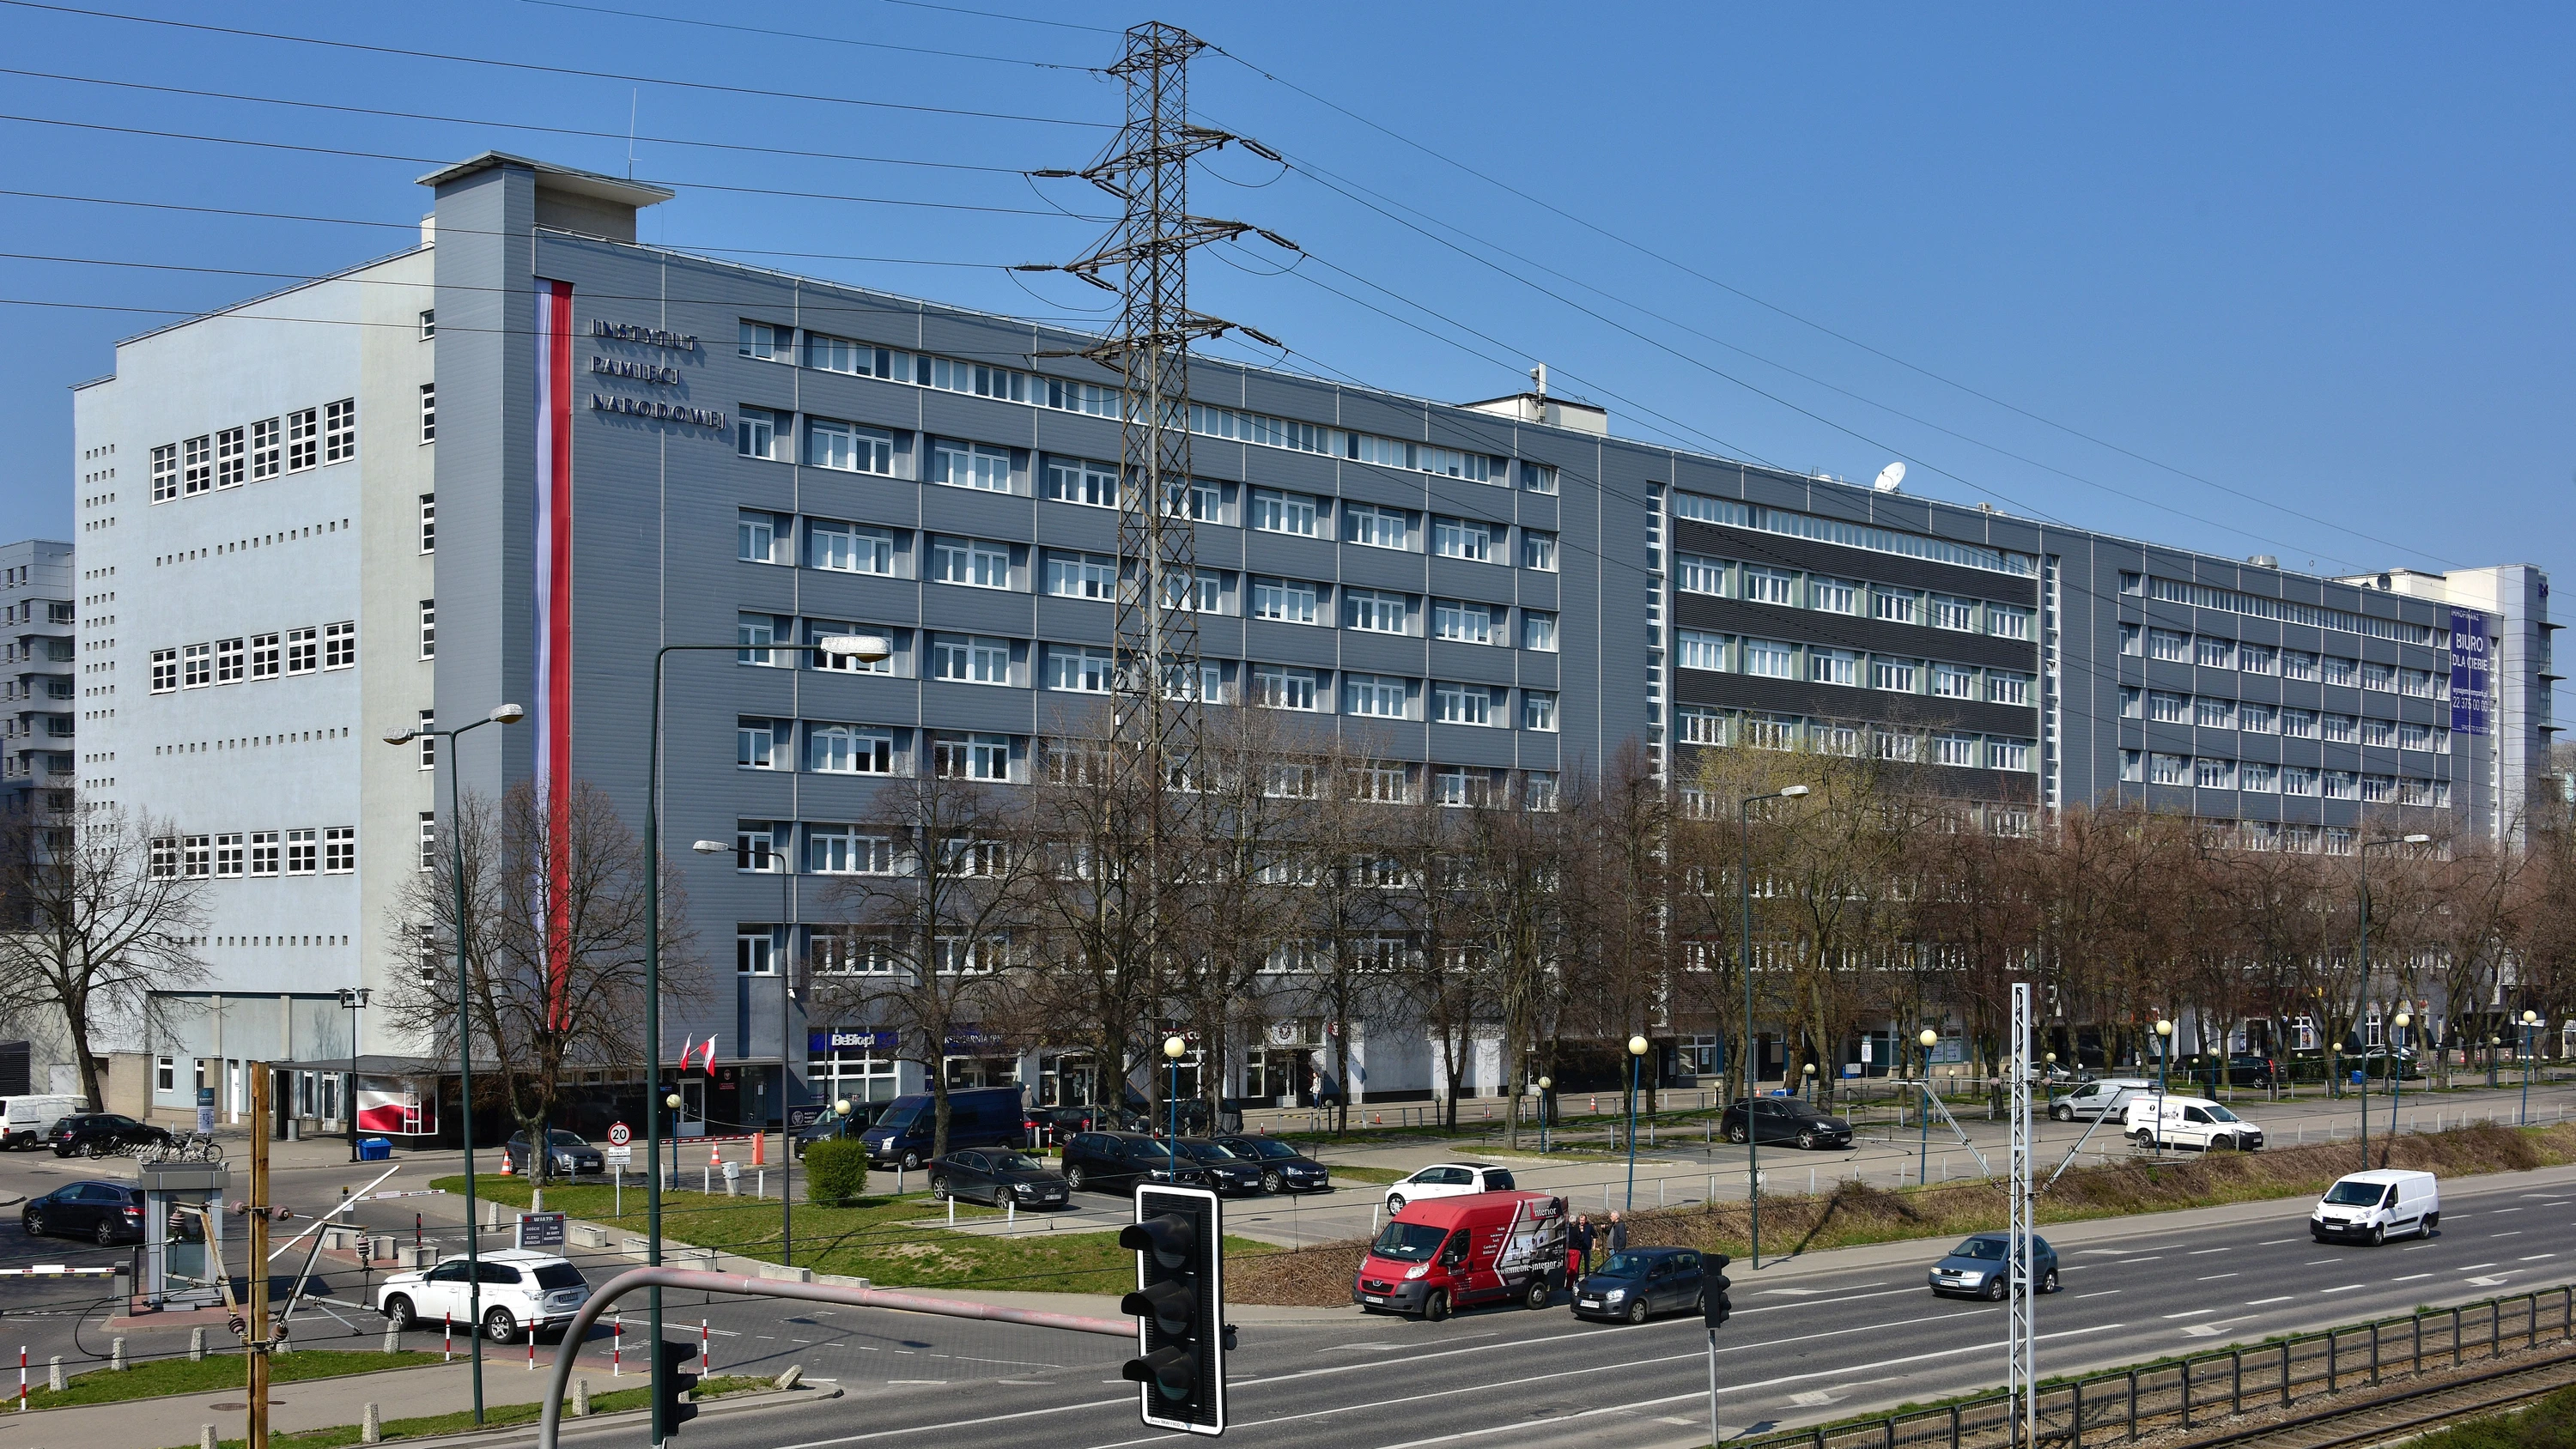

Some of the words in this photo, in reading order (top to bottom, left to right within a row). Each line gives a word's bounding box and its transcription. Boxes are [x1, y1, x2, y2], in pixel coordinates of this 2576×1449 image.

[590, 318, 698, 351] INSTYTUT
[590, 355, 681, 385] PAMIĘCI
[590, 392, 727, 430] NARODOWEJ
[2456, 633, 2483, 652] BIURO
[2452, 654, 2466, 668] DLA
[2467, 658, 2488, 671] CIEBIE
[2452, 696, 2460, 708] 22
[2473, 699, 2480, 711] 00
[612, 1129, 627, 1140] 20
[1528, 1202, 1557, 1220] Interior
